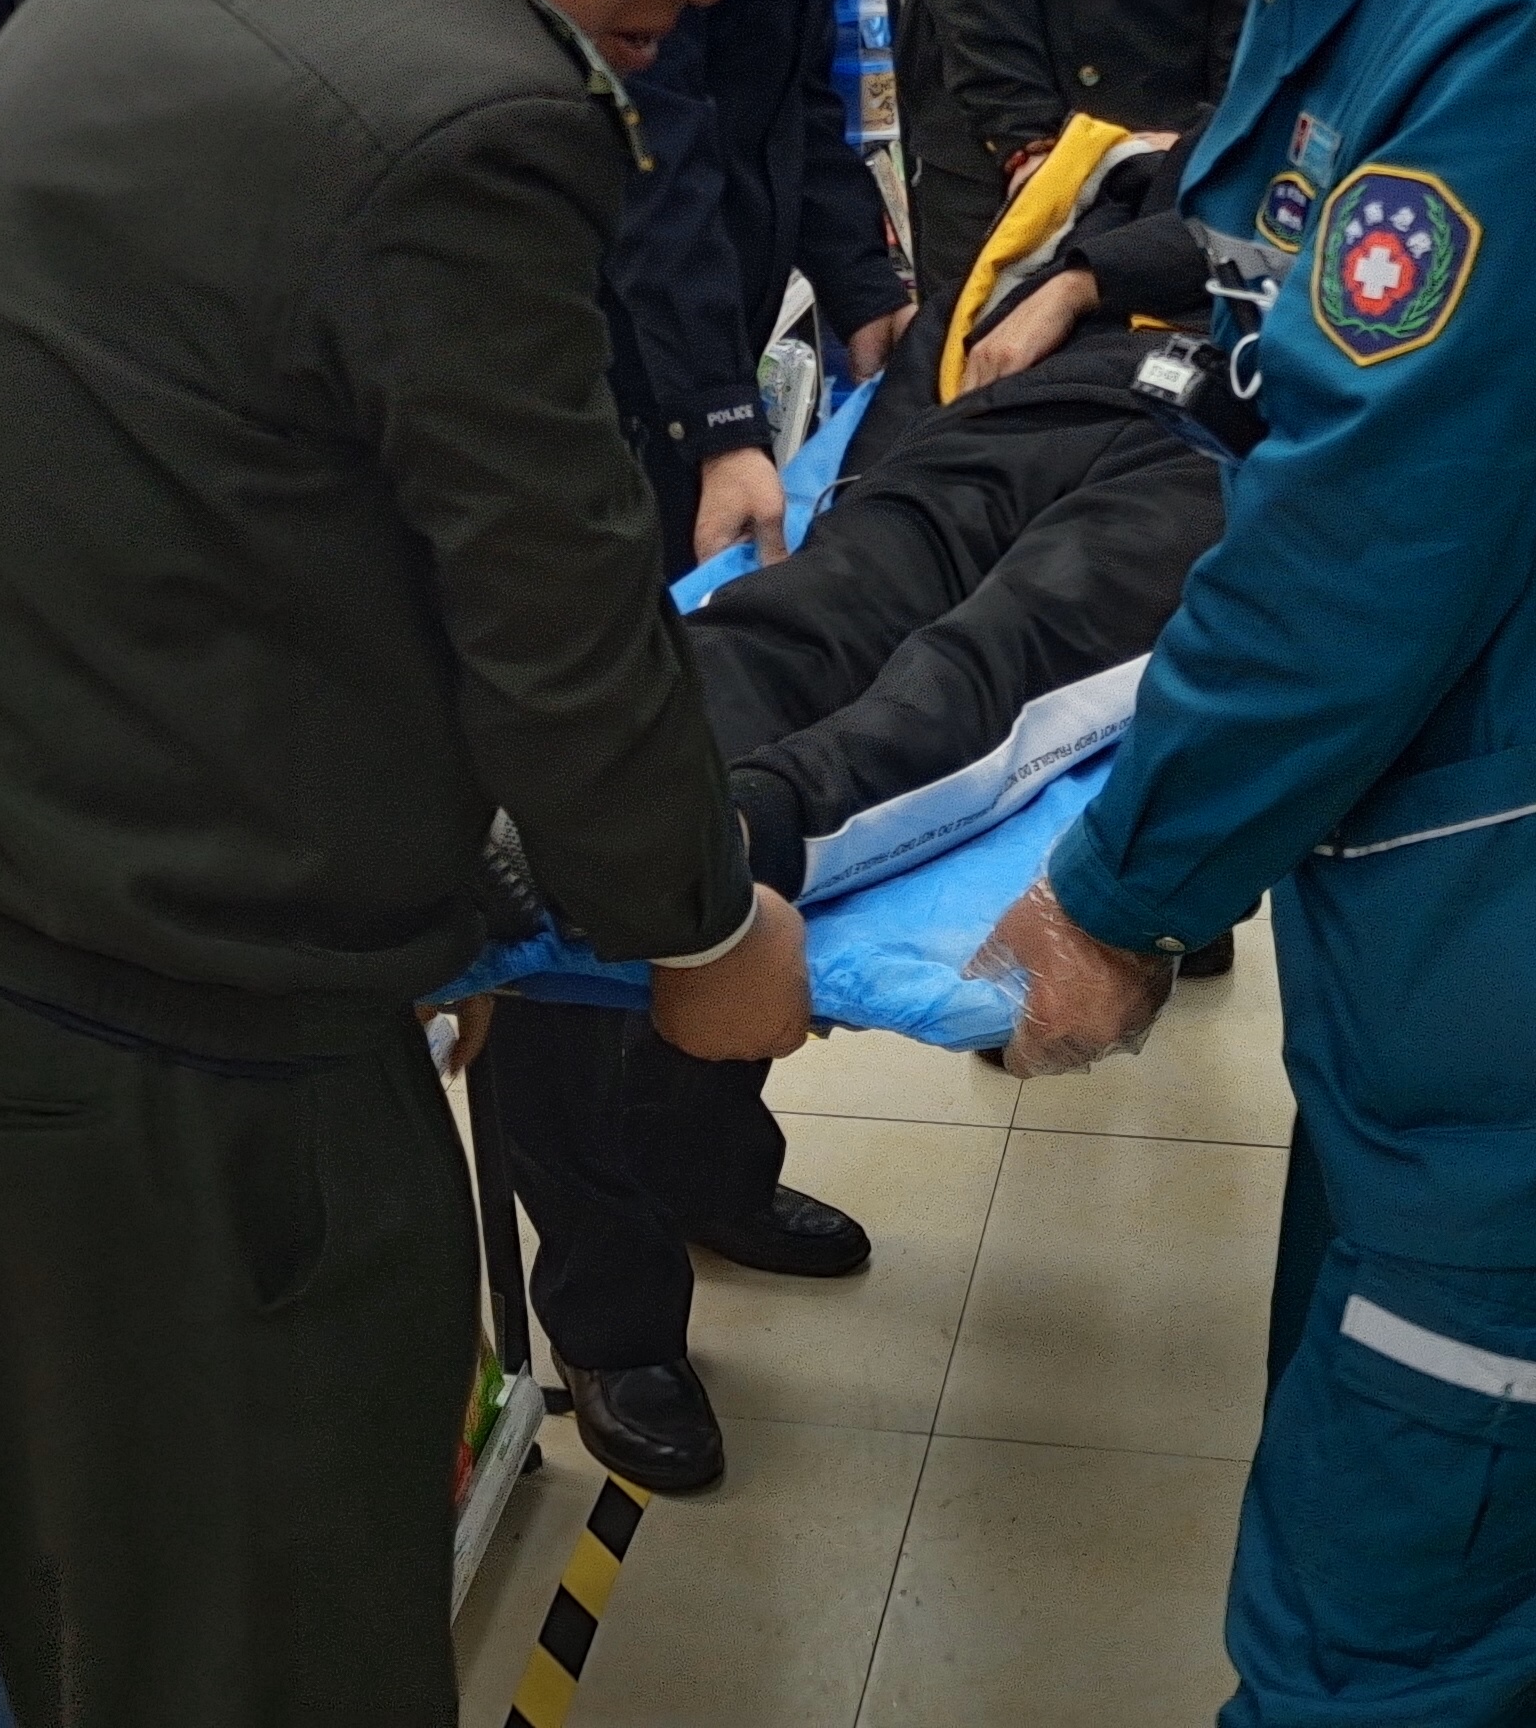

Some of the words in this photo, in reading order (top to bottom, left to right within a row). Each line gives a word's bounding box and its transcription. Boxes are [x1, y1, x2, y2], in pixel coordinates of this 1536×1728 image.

[707, 403, 755, 428] POLICE
[1074, 732, 1098, 752] DROP
[1031, 744, 1073, 773] FRAGILE
